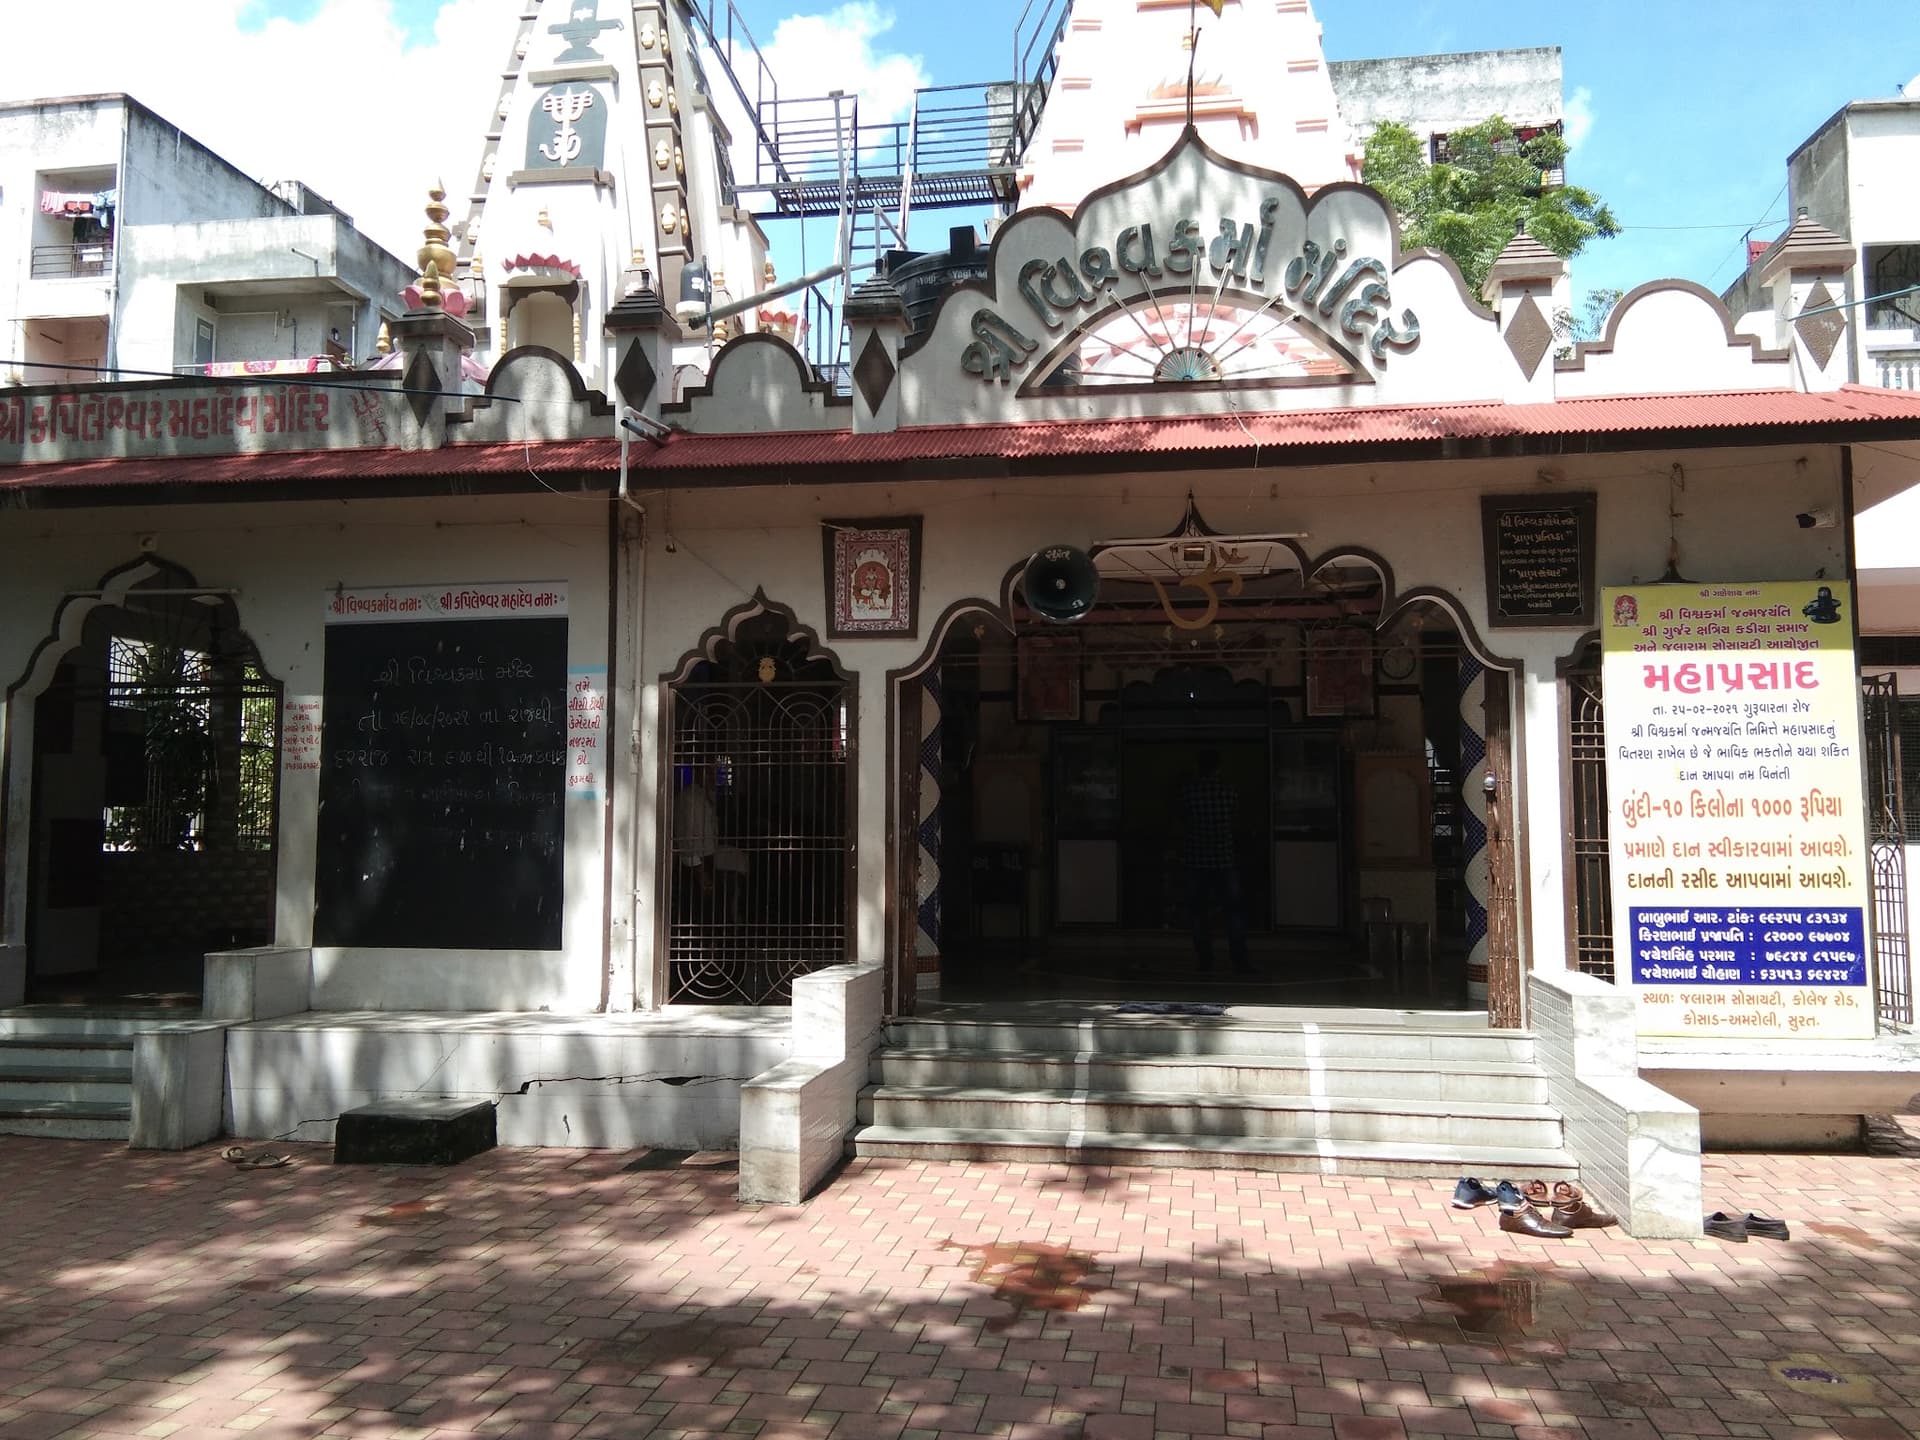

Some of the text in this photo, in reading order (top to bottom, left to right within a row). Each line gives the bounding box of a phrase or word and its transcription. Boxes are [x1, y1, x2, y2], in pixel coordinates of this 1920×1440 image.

[960, 308, 1040, 383] શ્રી
[1284, 238, 1421, 362] મંદિર
[29, 386, 162, 443] કપિલેશ્વર
[168, 386, 257, 439] મહાદેવ
[265, 385, 328, 433] મંદિર
[333, 594, 344, 615] શ્રી
[400, 598, 421, 612] નમઃ
[440, 590, 452, 610] શ્રી
[454, 591, 499, 610] કપિલેશ્વર
[502, 588, 532, 610] મહાદેવ
[535, 593, 557, 608] નમઃ
[1659, 604, 1791, 620] શ્રી વિશ્વકર્મા જન્મજયંતિ
[1642, 622, 1809, 640] શ્રી ગુર્જર ક્ષત્રિય કડીયા સમાજ
[1634, 637, 1819, 653] અને જલારામ સોસાયટી આયોજીત
[575, 676, 591, 693] તમે
[1643, 660, 1819, 694] મહાપ્રસાદ
[1652, 699, 1811, 718] તા. ૨૫-૦૨-૨૦૨૧ ગુરૂવારના રોજ
[1631, 719, 1836, 739] શ્રી વિશ્વકર્મા જન્મજયંતિ નિમિત્તે મહાપ્રસાદનું
[1618, 745, 1653, 760] વિતરણ
[1657, 745, 1685, 760] રાખેલ
[1690, 745, 1698, 759] છે
[1703, 745, 1712, 758] જે
[1716, 744, 1748, 758] ભાવિક
[1797, 746, 1816, 756] યથા
[1679, 765, 1790, 781] દાન આપવા નમ્ર વિનંતી
[1622, 788, 1842, 828] બુંદી-૧૦ કિલોના ૧૦૦૦ રૂપિયા
[1623, 834, 1852, 859] પ્રમાણે દાન સ્વીકારવામાં આવશે.
[1627, 866, 1852, 889] દાનની રસીદ આપવામાં આવશે.
[1638, 910, 1689, 927] બાબુભાઈ
[1693, 912, 1722, 924] આર.
[1759, 912, 1802, 924] ૯૯૨૫૫
[1806, 912, 1848, 924] ૮૩૧૩૪
[1638, 927, 1695, 943] કિરણભાઈ
[1700, 928, 1744, 943] પ્રજાપતિ
[1763, 931, 1804, 942] ૮૨૦૦૦
[1808, 931, 1850, 942] ૯૭૭૦૪
[1640, 946, 1694, 962] જયેશસિંહ
[1699, 951, 1735, 961] પરમાર
[1765, 951, 1807, 962] ૭૯૮૪૪
[1812, 951, 1855, 962] ૮૧૫૯૭
[1640, 964, 1697, 980] જયેશભાઈ
[1701, 964, 1740, 980] ચૌહાણ
[1760, 970, 1802, 981] ૬૩૫૧૩
[1807, 970, 1848, 981] ૬૯૪૨૪
[1679, 993, 1726, 1005] જલારામ
[1731, 990, 1785, 1007] સોસાયટી,
[1793, 990, 1827, 1006] કોલેજ
[1834, 990, 1858, 1008] રોડ,
[1788, 1014, 1820, 1032] સુરત.
